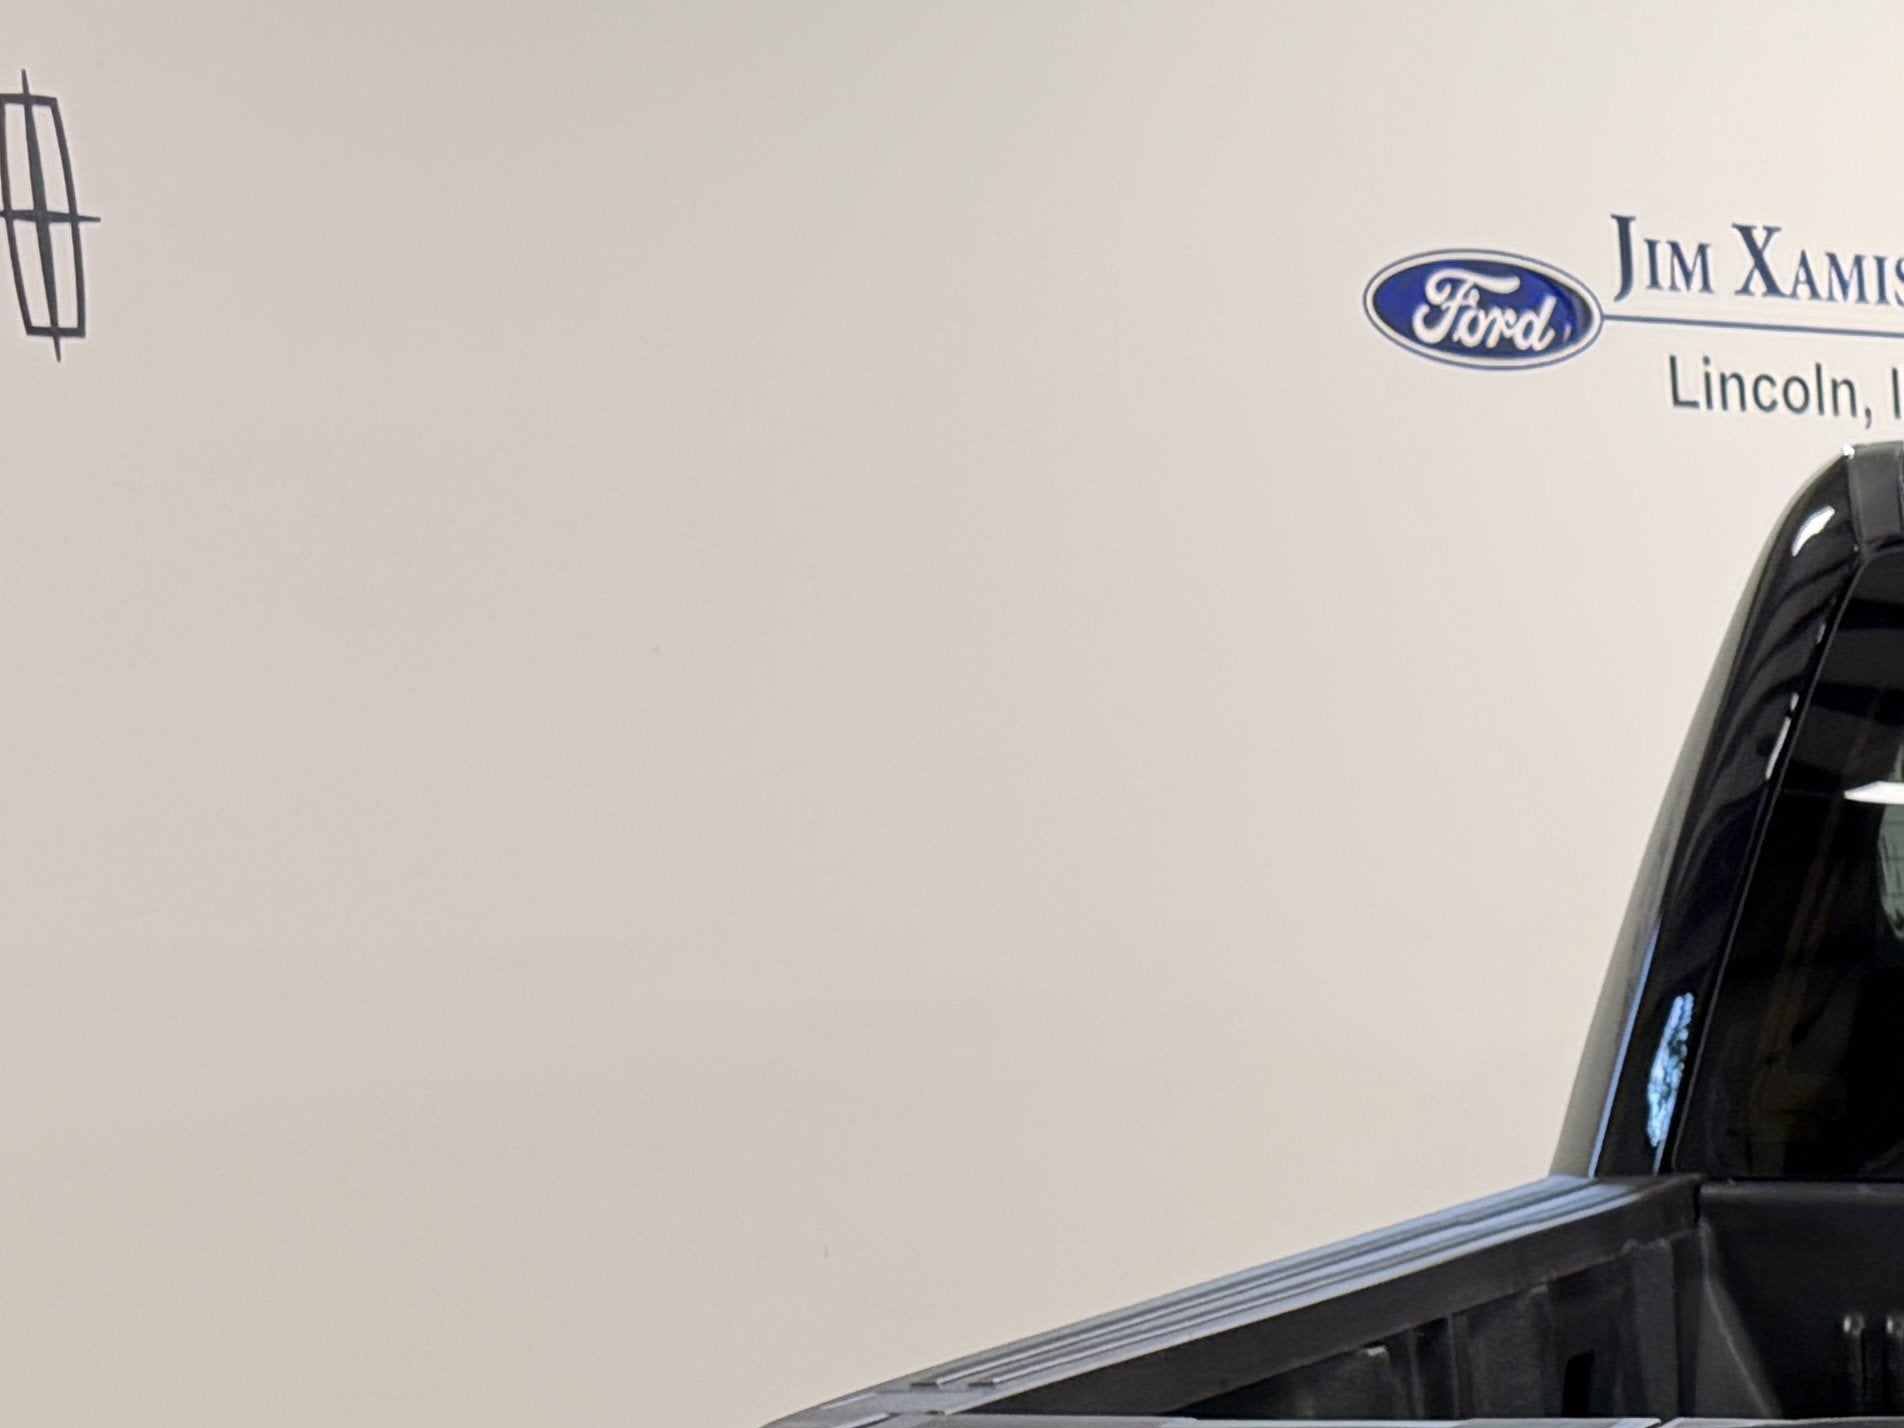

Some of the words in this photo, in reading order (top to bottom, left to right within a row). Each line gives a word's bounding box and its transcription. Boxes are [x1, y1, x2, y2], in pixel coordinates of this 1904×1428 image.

[1609, 214, 1713, 302] JIM
[1413, 268, 1556, 353] Ford
[1669, 355, 1876, 430] Lincoln,
